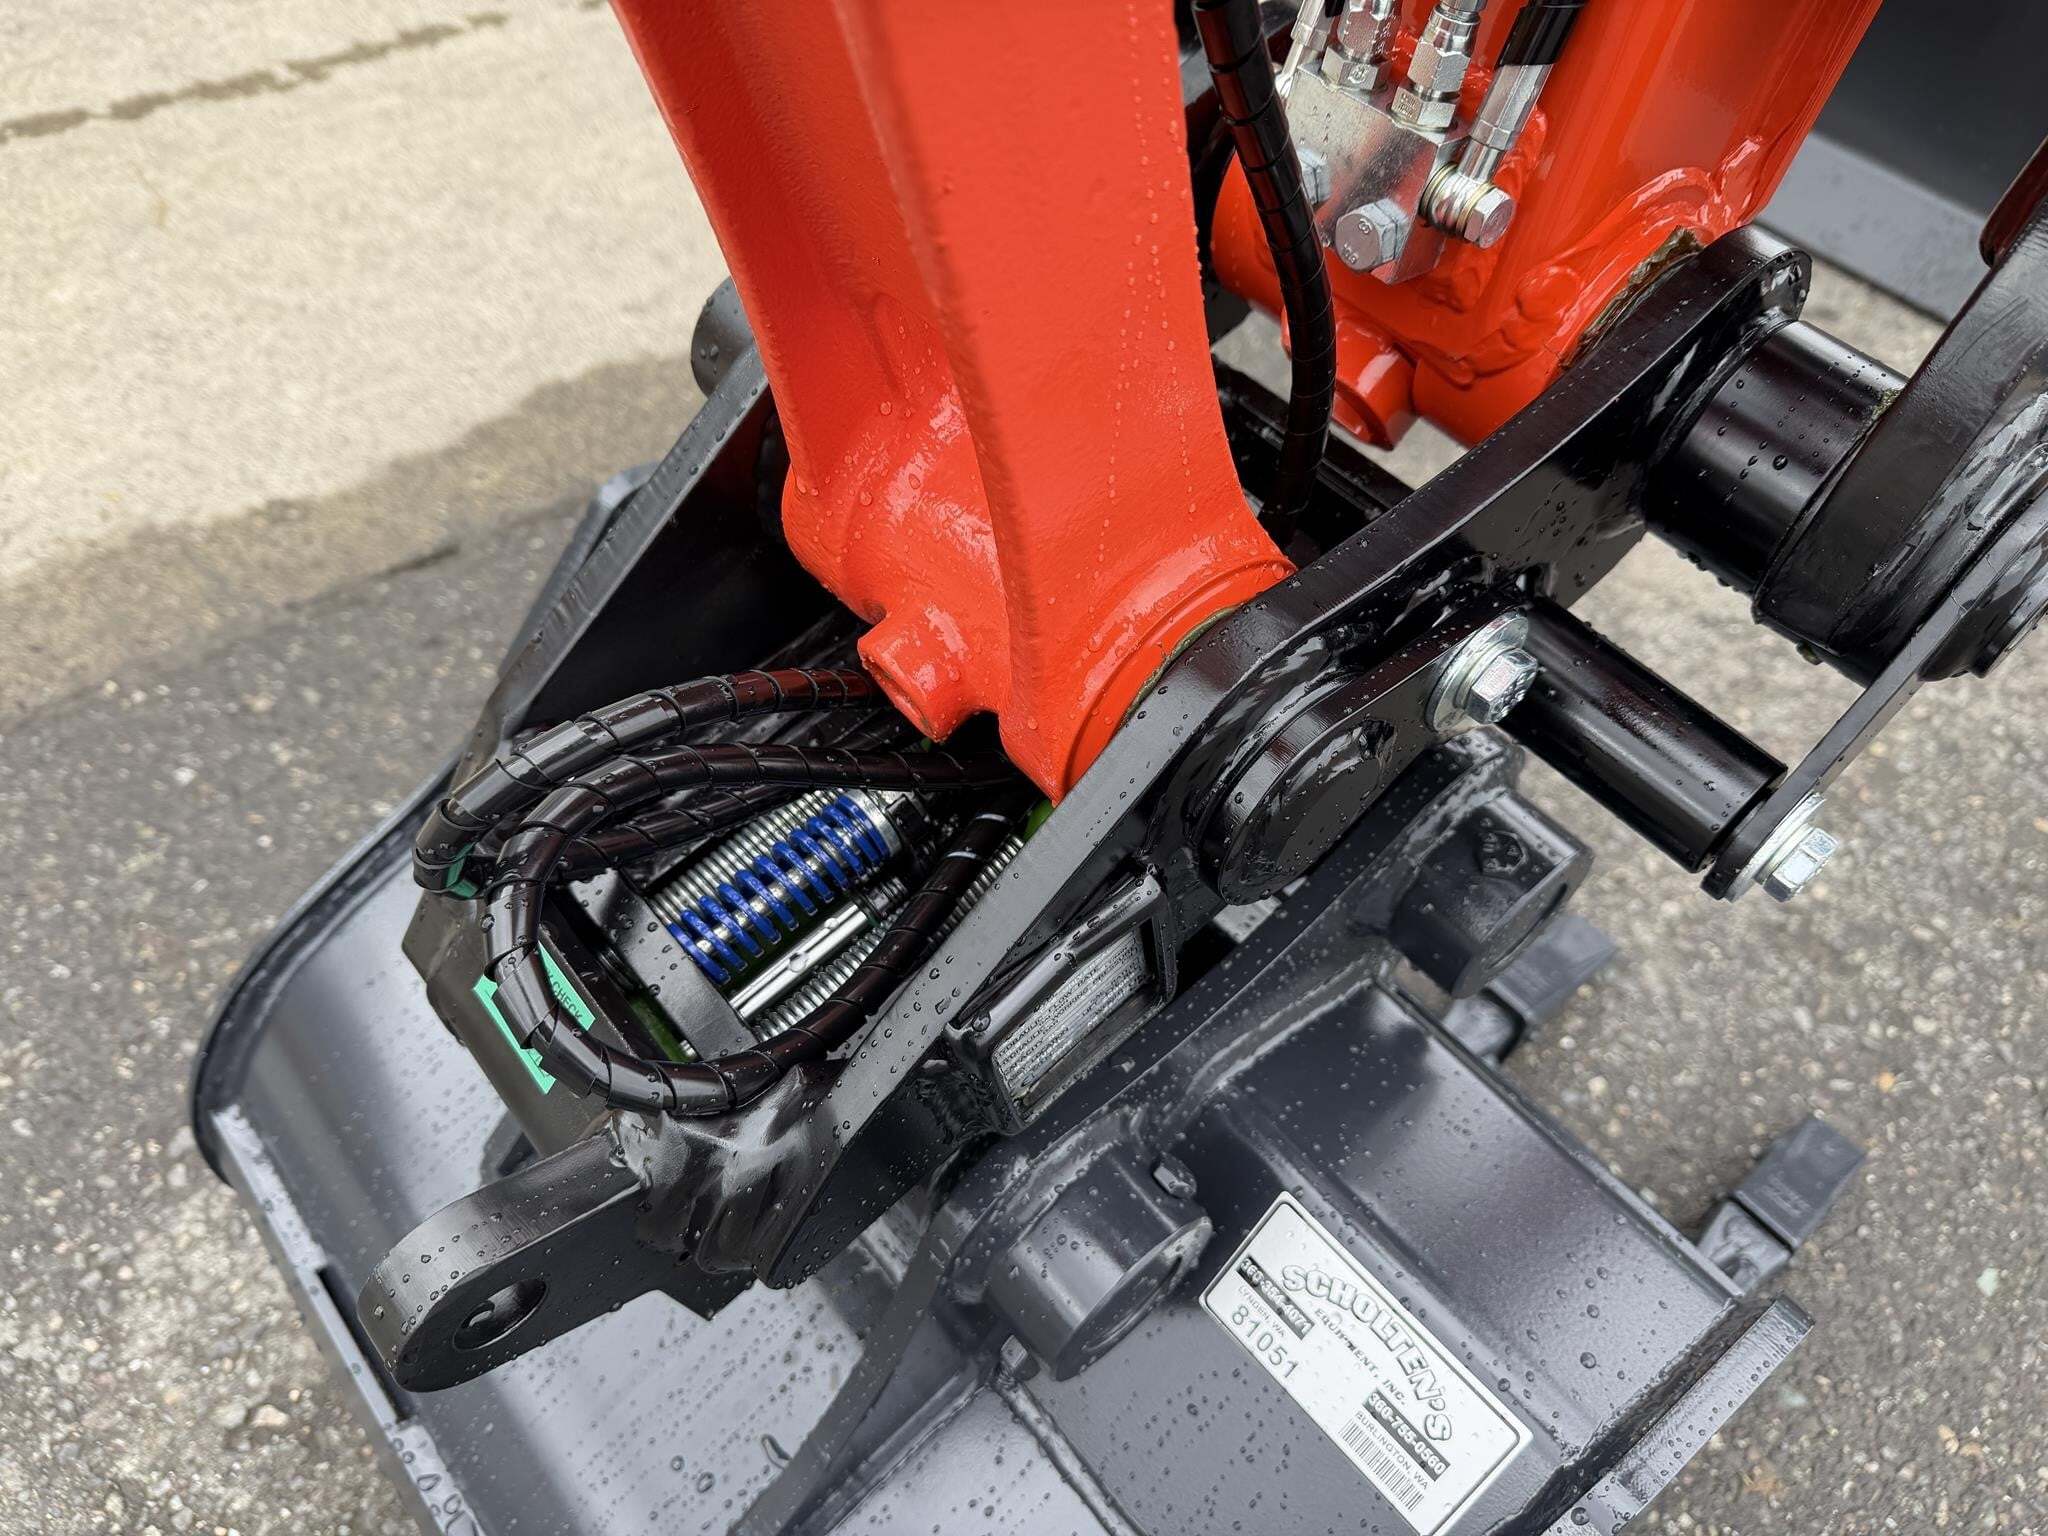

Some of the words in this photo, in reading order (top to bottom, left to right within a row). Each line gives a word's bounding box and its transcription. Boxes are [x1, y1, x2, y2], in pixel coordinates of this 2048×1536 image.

[1240, 1257, 1312, 1334] 360-354-4071
[1270, 1320, 1286, 1338] WA
[1231, 1304, 1299, 1379] 81051
[1282, 1266, 1451, 1441] SCHOLTEN'S
[1313, 1307, 1380, 1378] EQUIPMENT,
[1382, 1378, 1408, 1406] INC.
[1355, 1410, 1412, 1472] BURLINGTON,
[1413, 1472, 1429, 1490] WA
[1367, 1391, 1446, 1474] 360-755-0560
